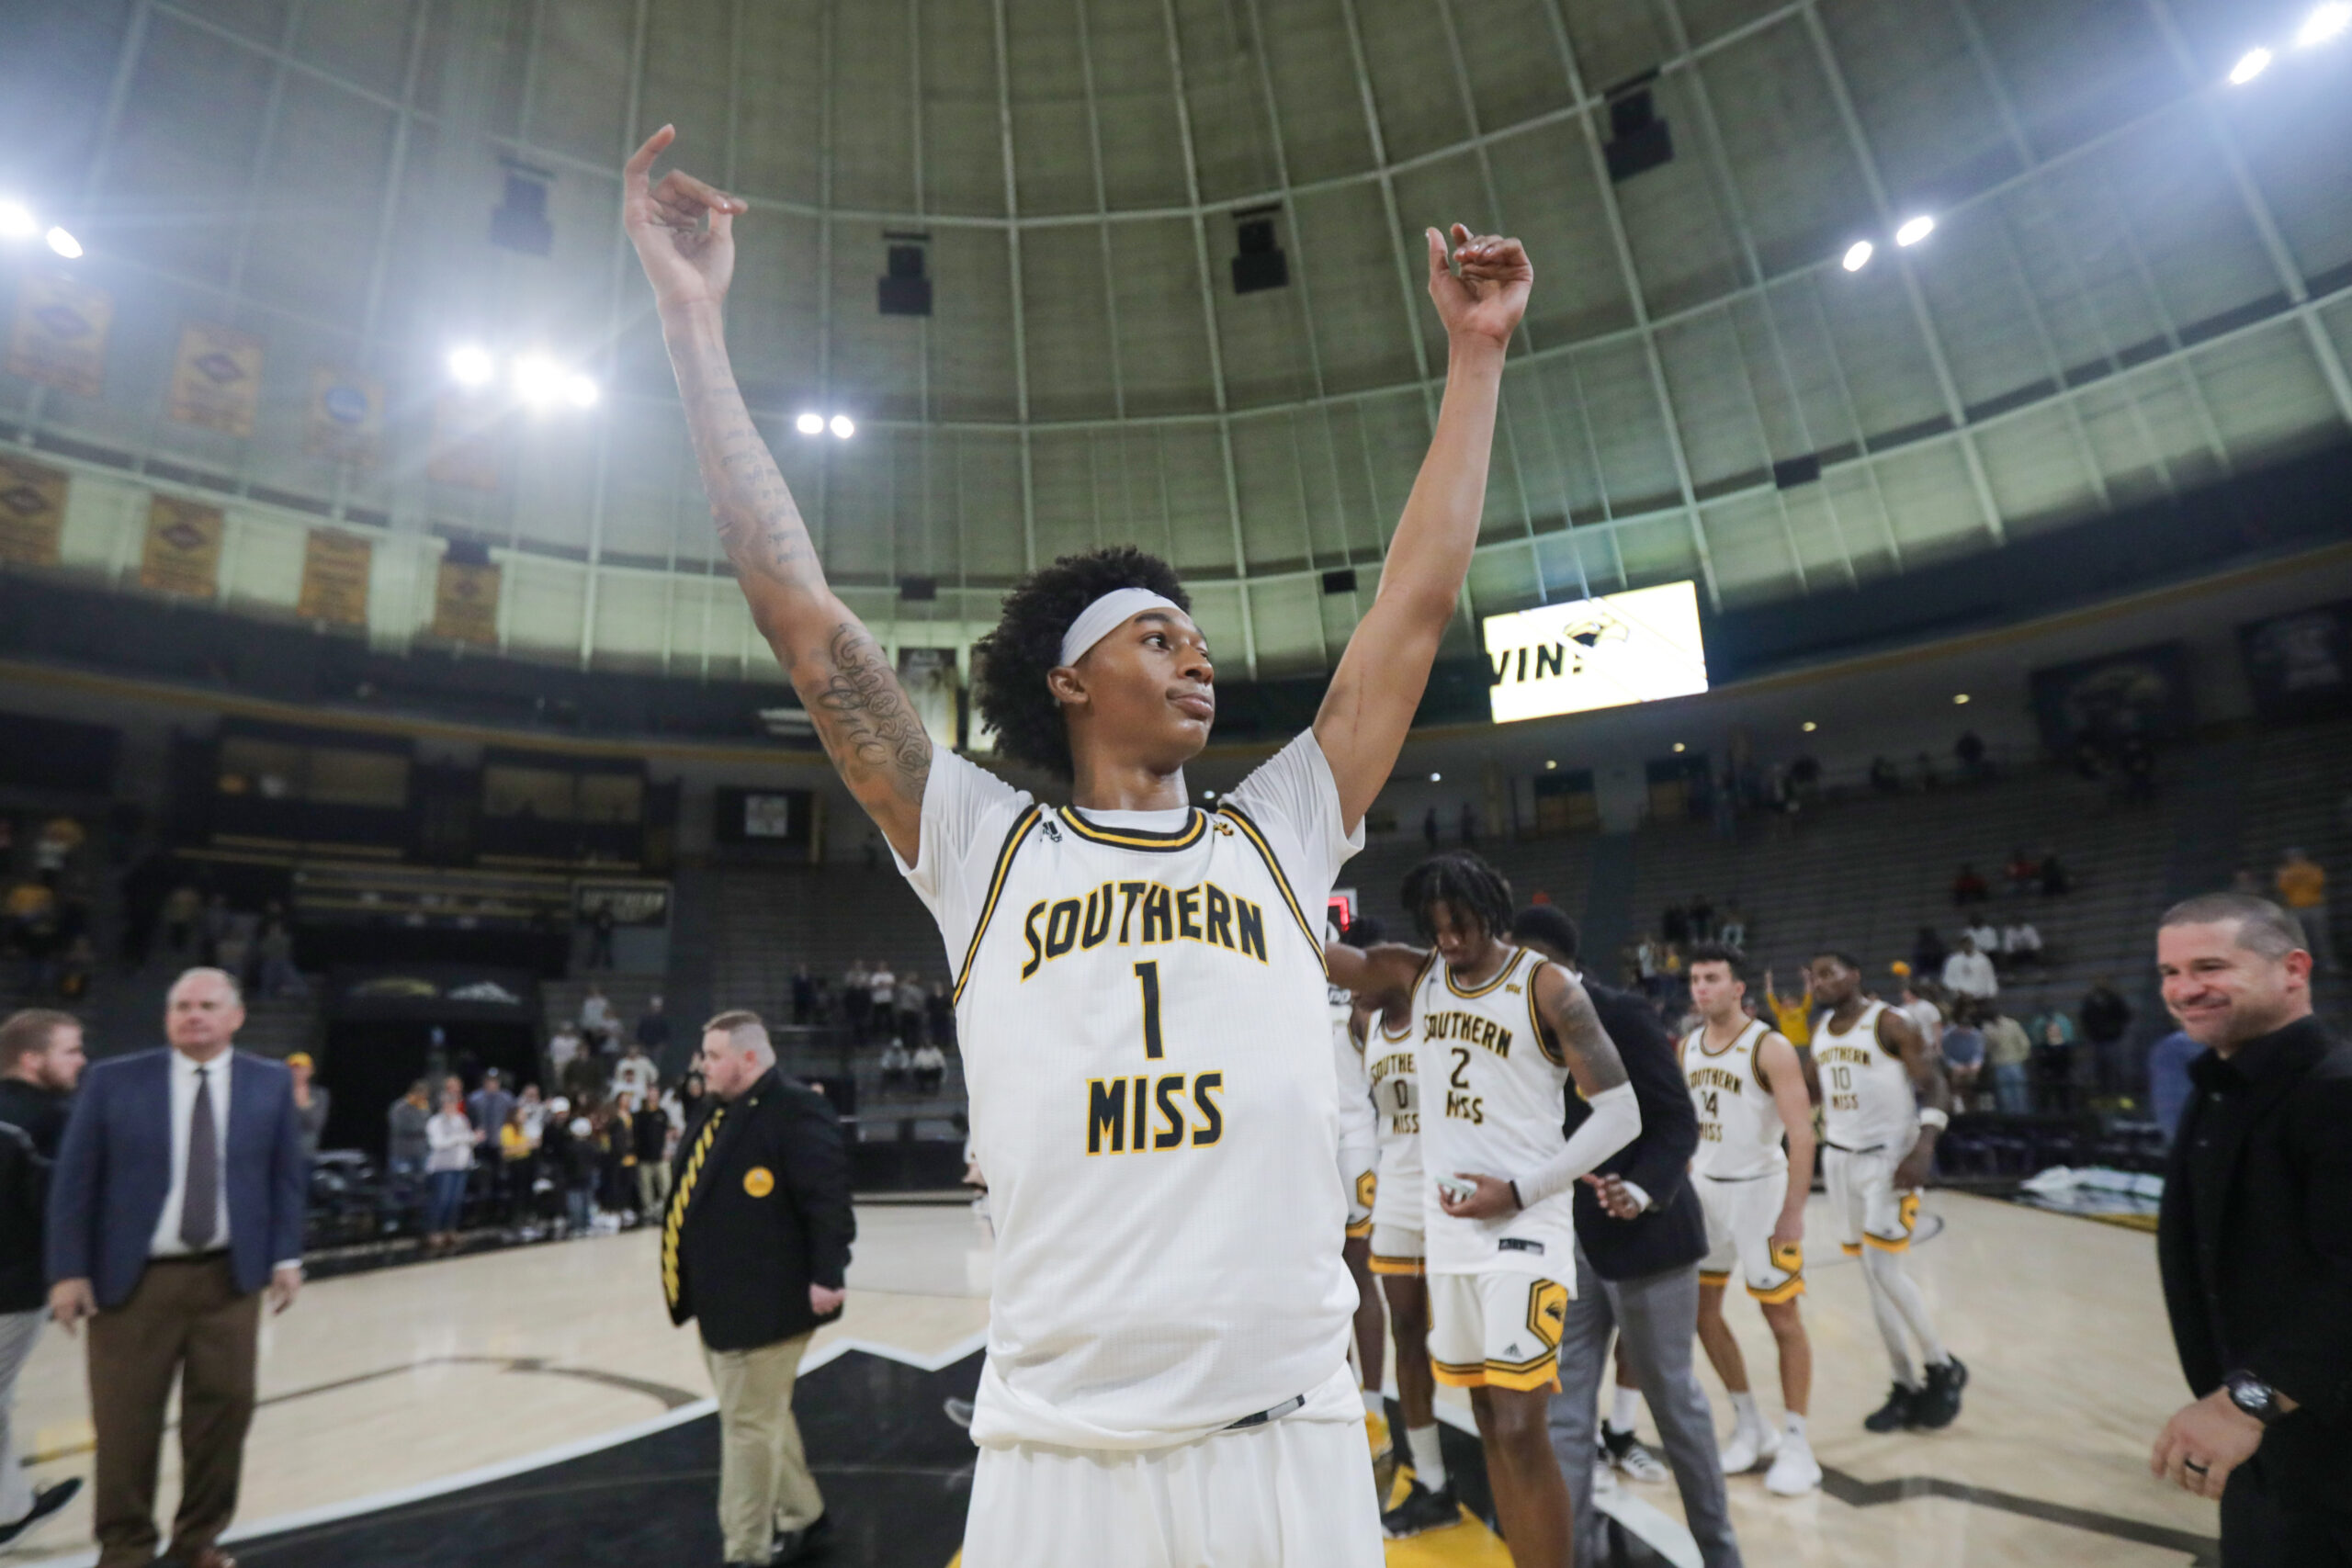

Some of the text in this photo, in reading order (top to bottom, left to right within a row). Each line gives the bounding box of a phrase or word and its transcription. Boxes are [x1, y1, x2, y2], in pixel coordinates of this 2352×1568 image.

[1020, 880, 1269, 984] SOUTHERN
[1132, 959, 1165, 1061] 1
[1370, 1053, 1418, 1088] SOUTHE
[1450, 1047, 1471, 1089] 2
[1830, 1066, 1852, 1091] 10
[1086, 1069, 1224, 1156] MISS
[1393, 1078, 1408, 1110] 0
[1445, 1089, 1484, 1126] MSS
[1832, 1093, 1860, 1111] MISS
